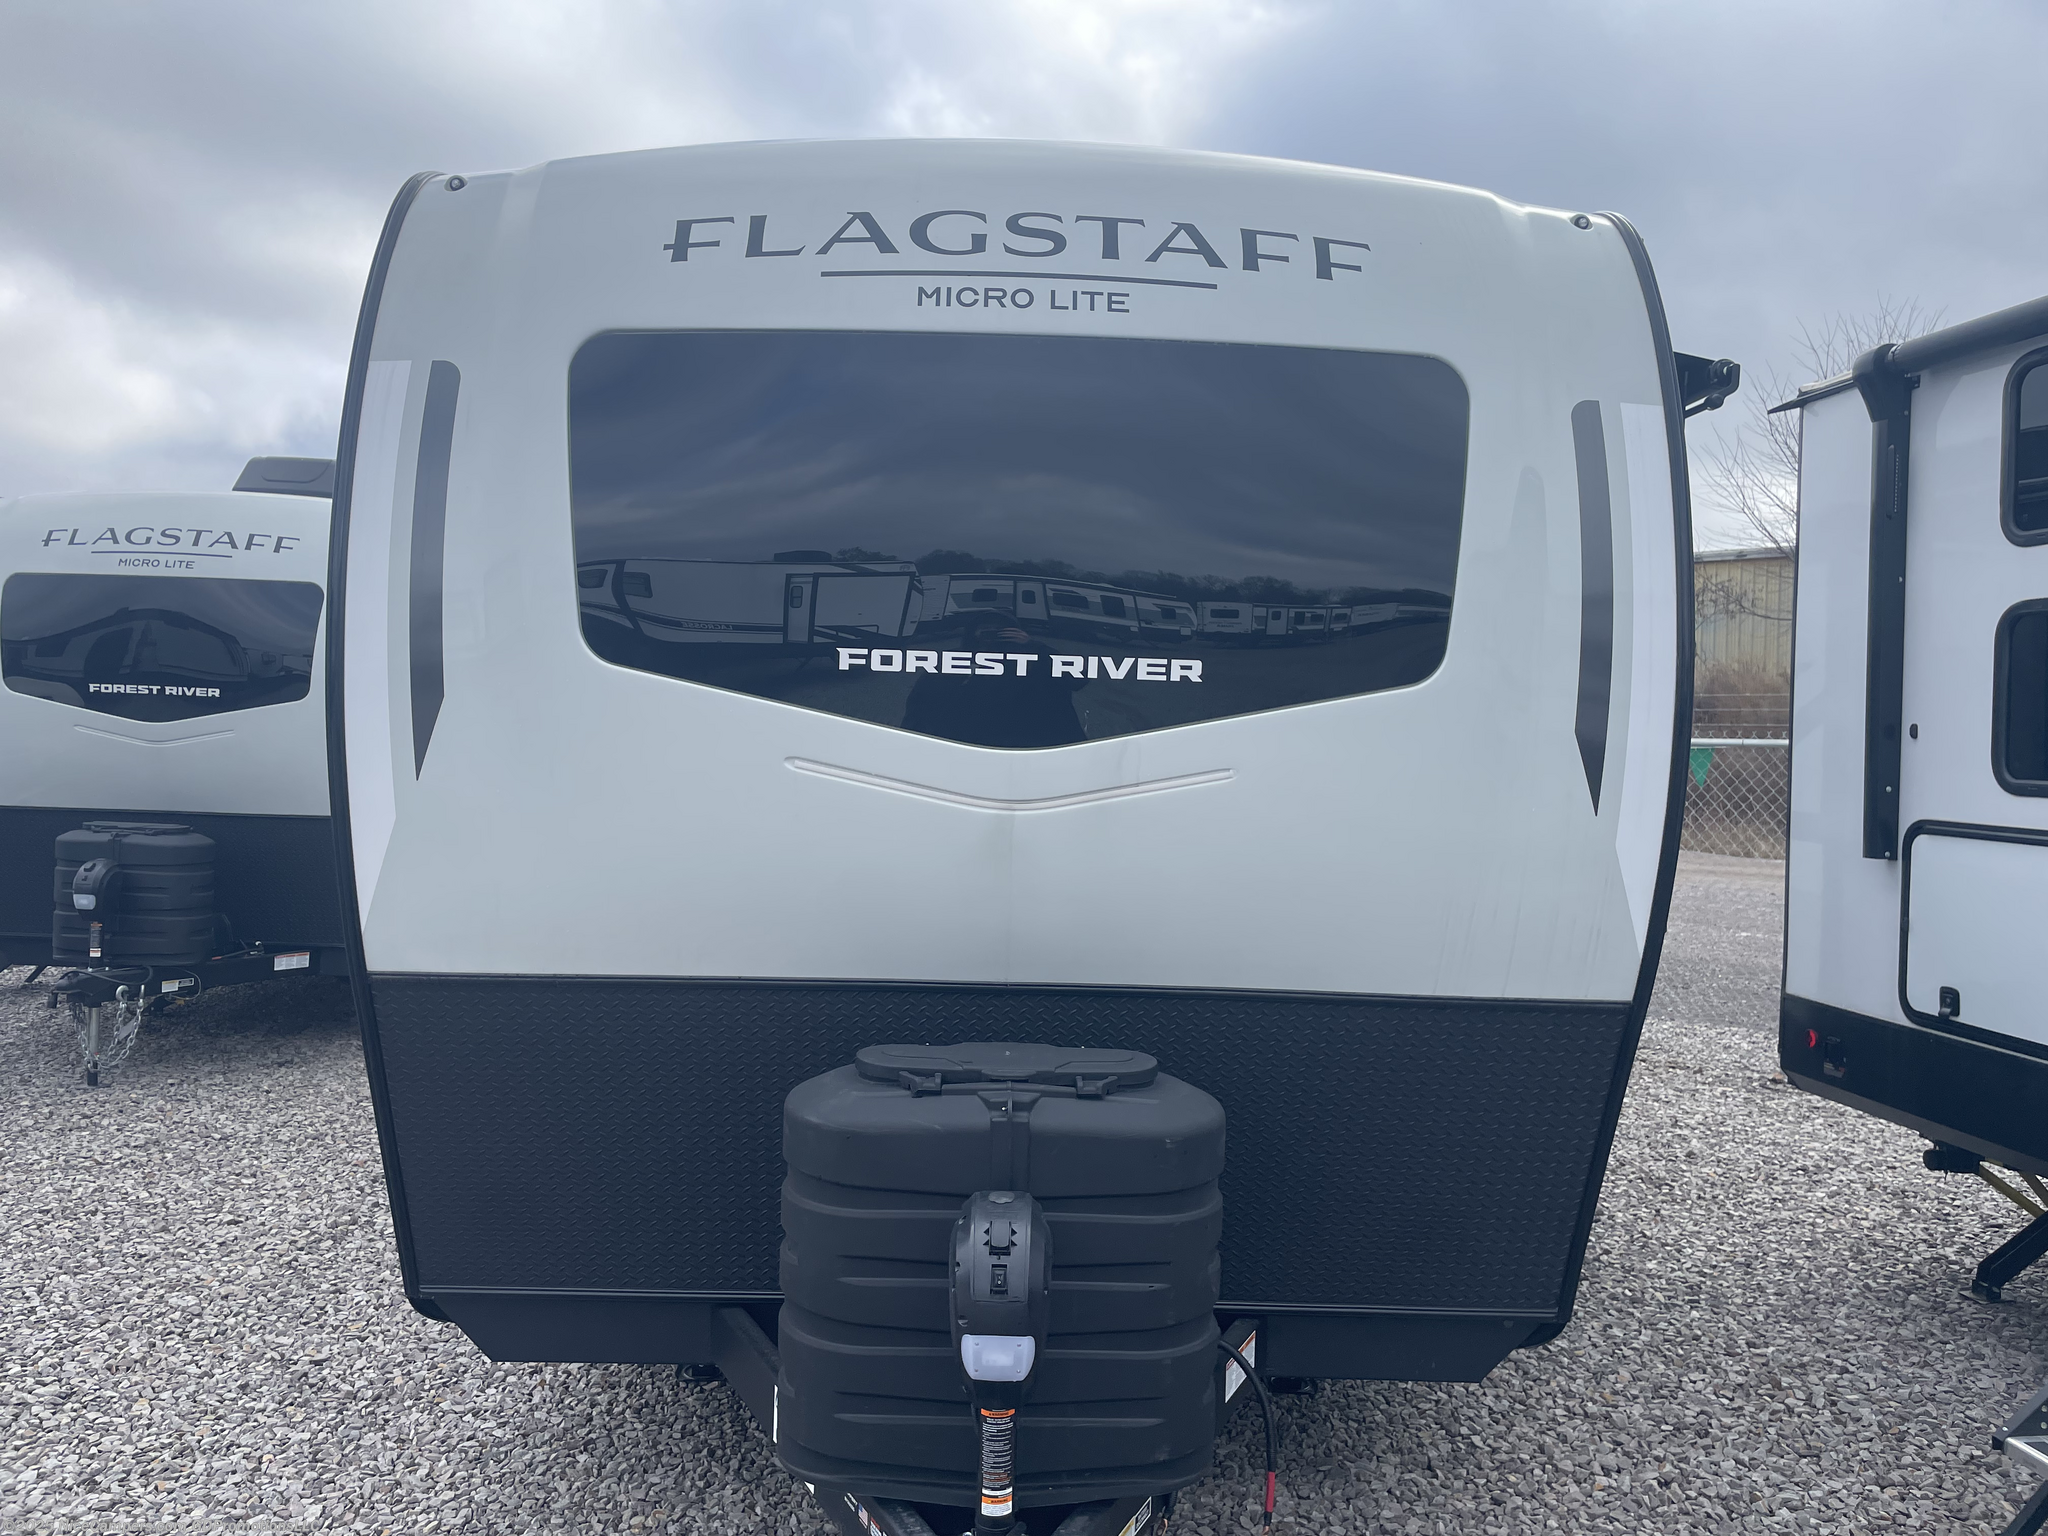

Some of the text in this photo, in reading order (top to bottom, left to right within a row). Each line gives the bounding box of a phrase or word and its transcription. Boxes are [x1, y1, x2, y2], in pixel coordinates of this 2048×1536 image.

[662, 209, 1371, 281] FLAGSTAFF
[916, 286, 1130, 314] MICRO LITE
[41, 527, 301, 554] FLAGSTAFF
[118, 558, 195, 570] MICRO LITE
[836, 646, 1204, 684] FOREST RIVER
[88, 683, 220, 698] FOREST RIVER
